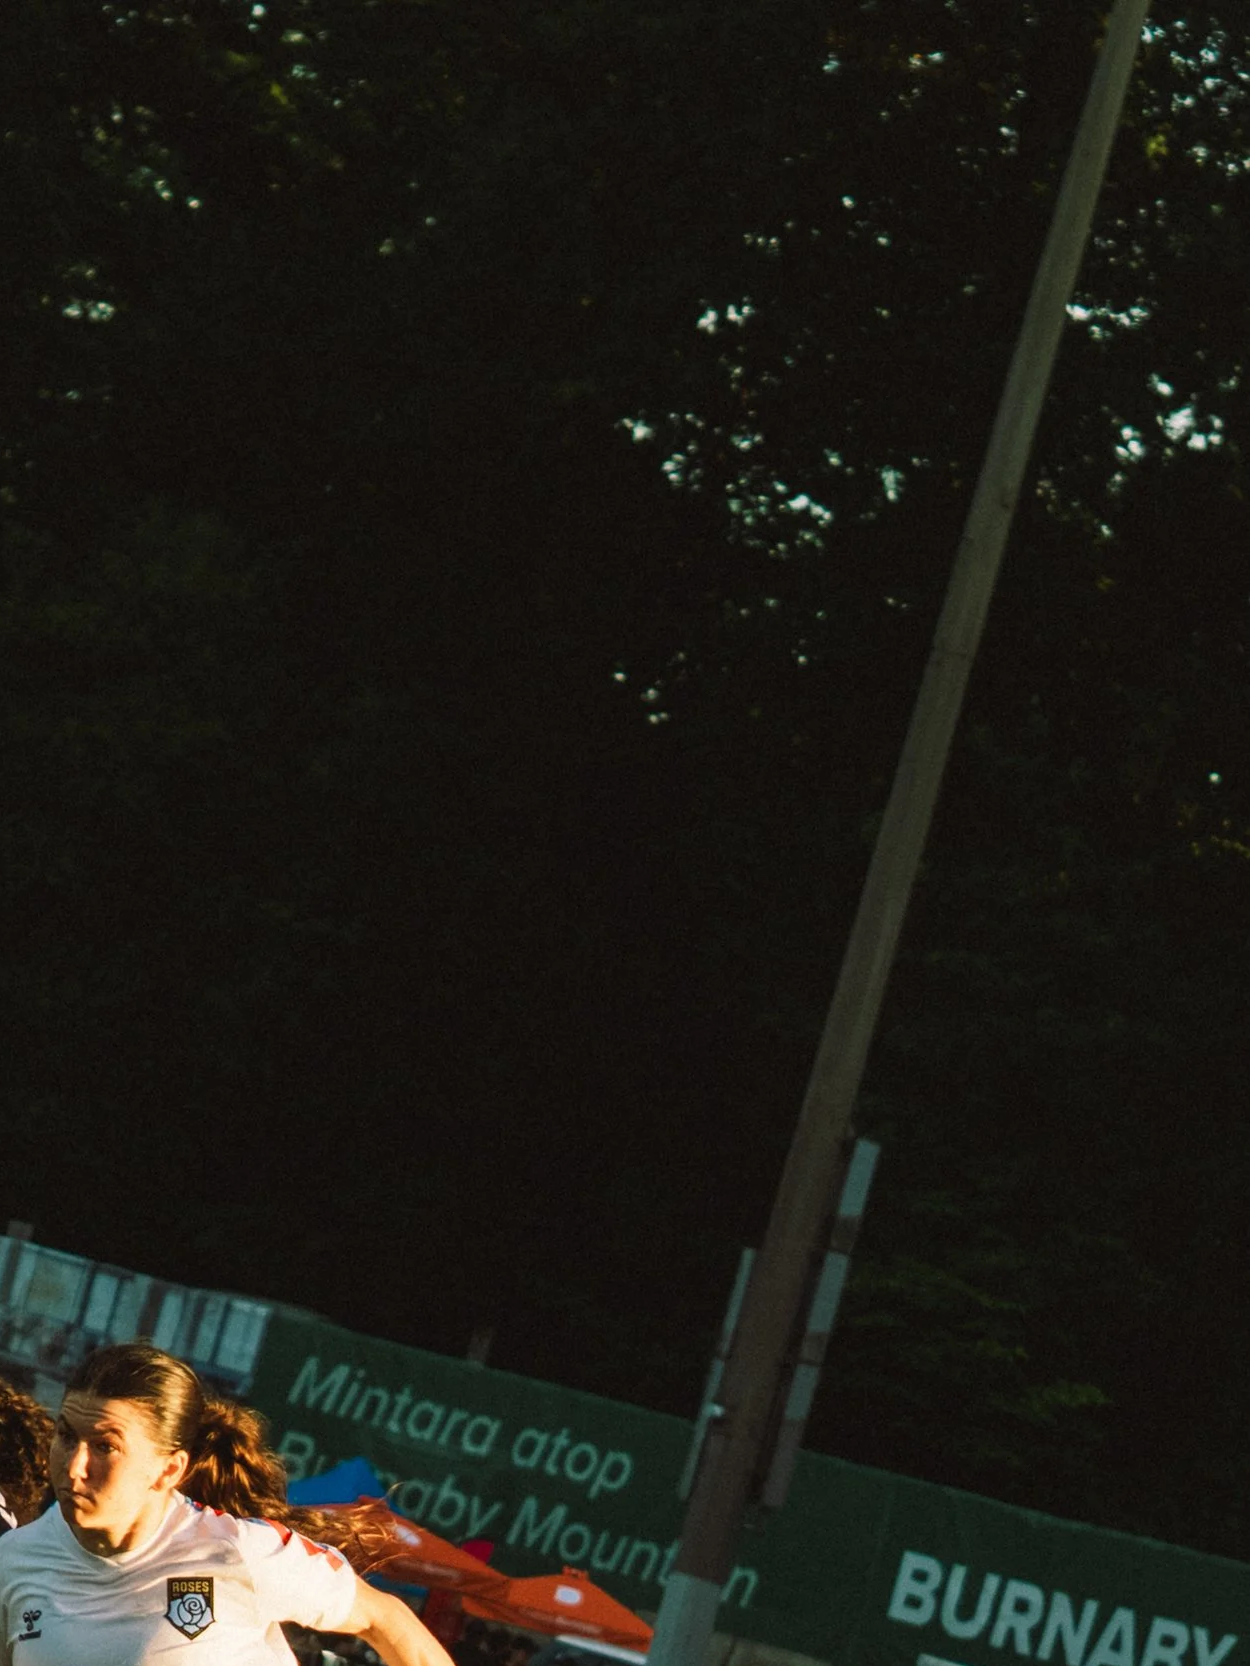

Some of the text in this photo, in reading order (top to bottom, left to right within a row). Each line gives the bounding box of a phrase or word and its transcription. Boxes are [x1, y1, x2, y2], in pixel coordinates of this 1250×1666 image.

[288, 1355, 633, 1501] Mintara atop
[172, 1581, 210, 1593] ROSES
[280, 1430, 759, 1608] Baby Mountn
